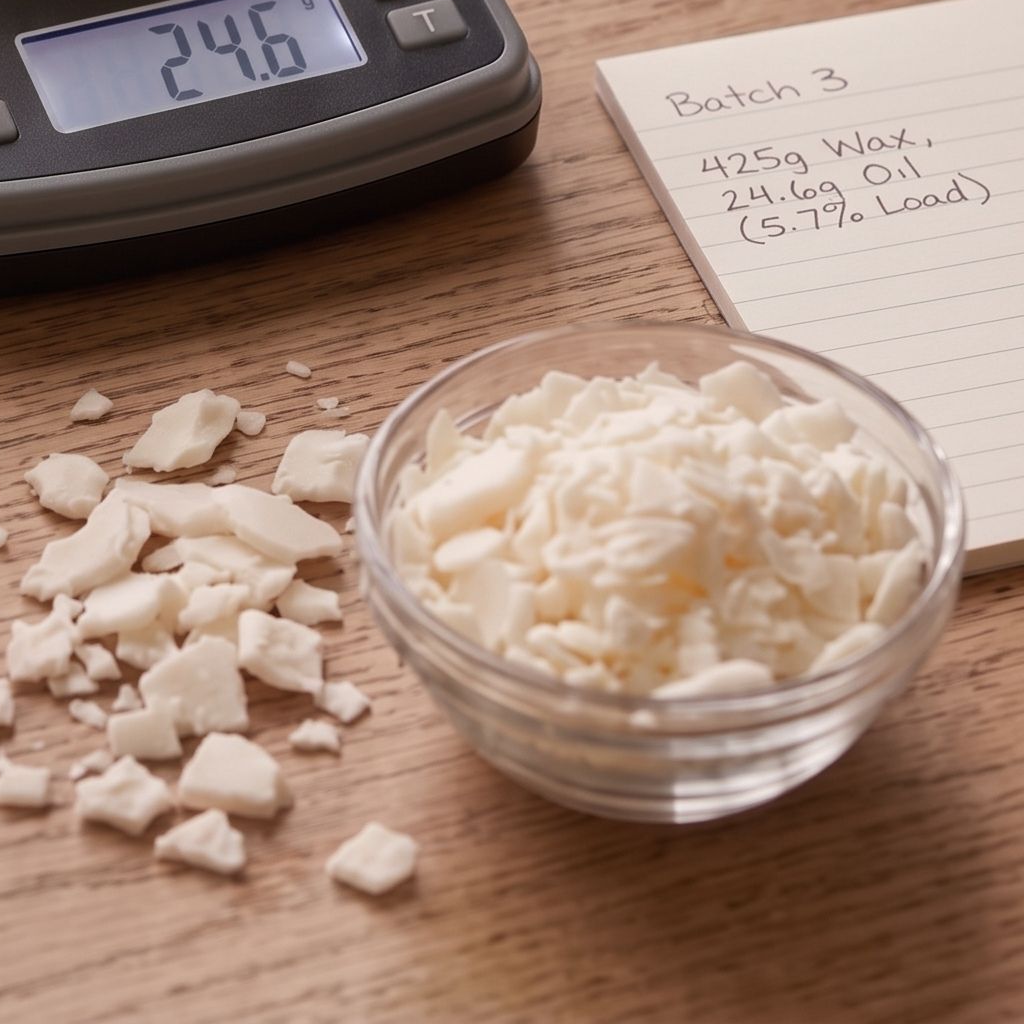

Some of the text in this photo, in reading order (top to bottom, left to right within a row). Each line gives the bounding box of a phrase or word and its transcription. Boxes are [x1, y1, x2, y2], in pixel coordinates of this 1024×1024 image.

[412, 8, 435, 33] T
[148, 0, 307, 102] 24.6
[665, 67, 849, 118] Batch 3
[701, 127, 933, 179] 425g Wax,
[721, 155, 922, 212] 24.6g Oil
[739, 171, 991, 245] (5.7% Load)
